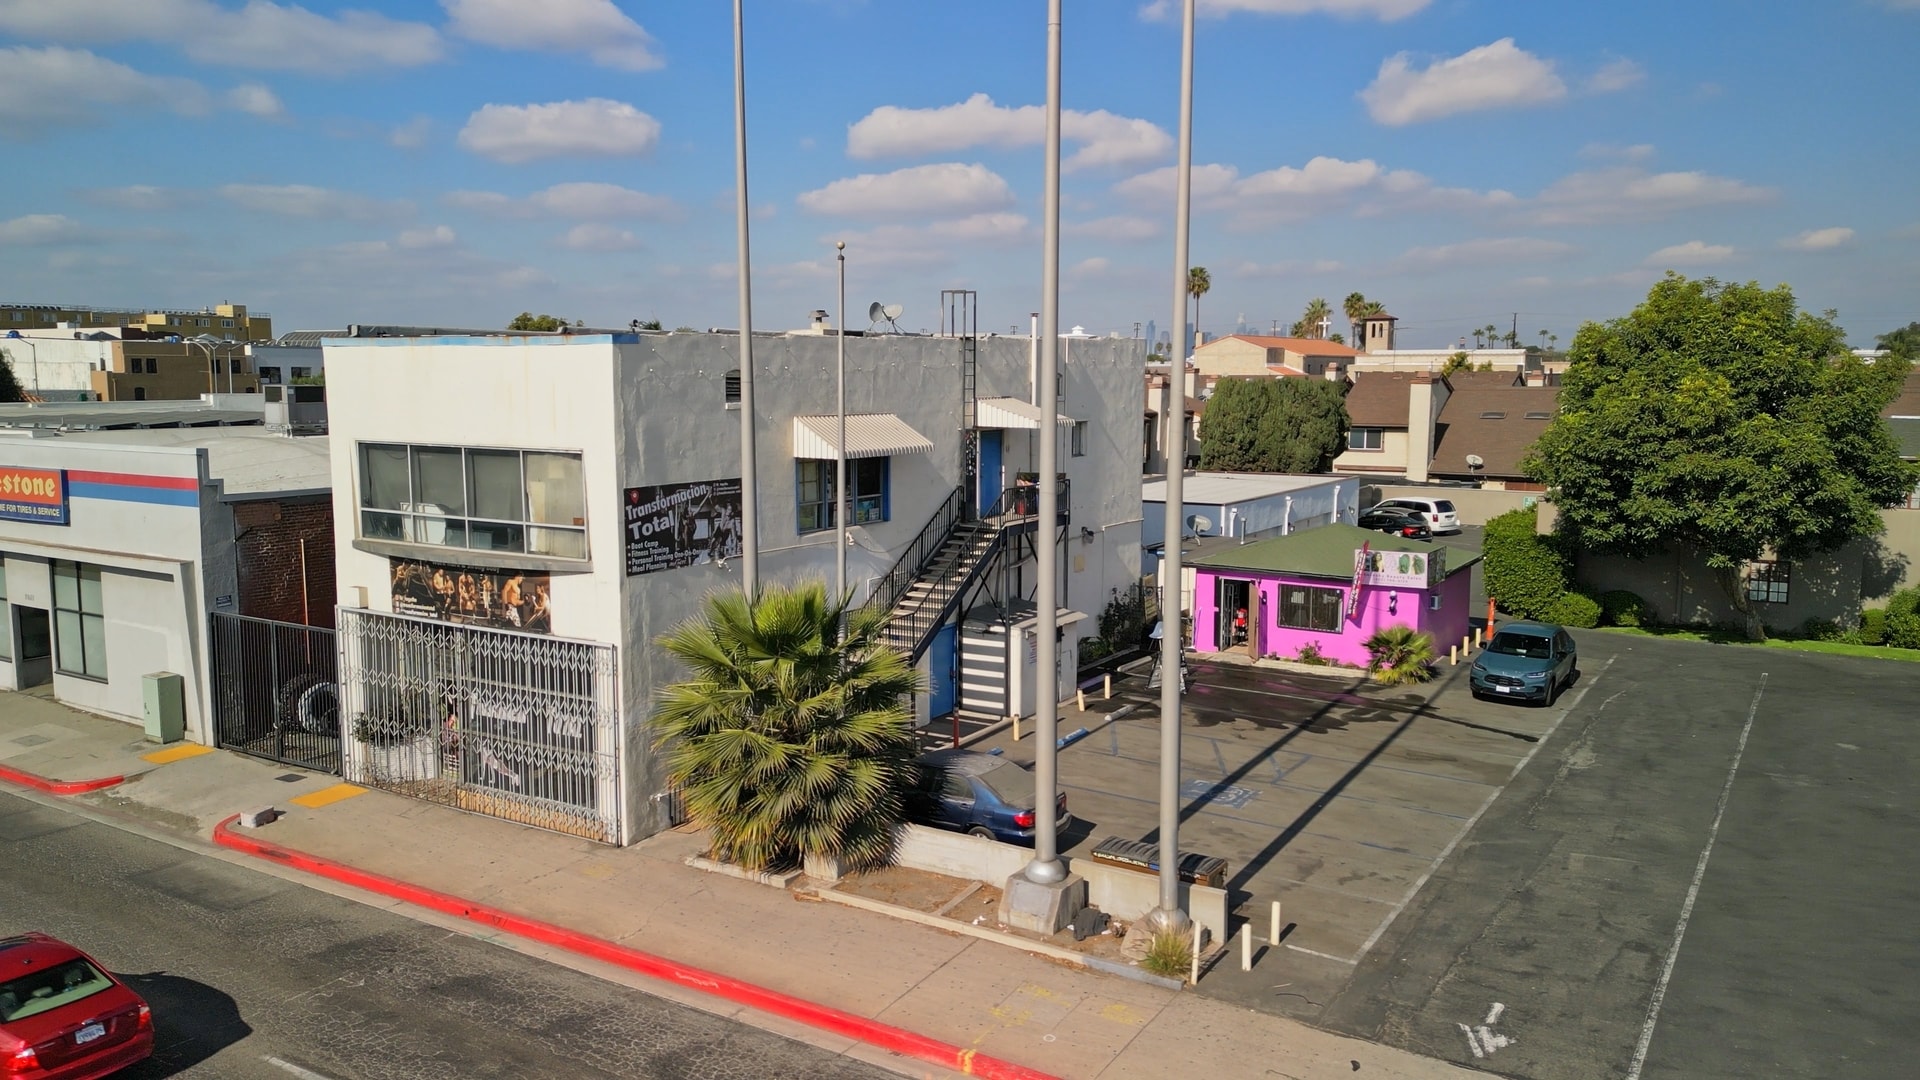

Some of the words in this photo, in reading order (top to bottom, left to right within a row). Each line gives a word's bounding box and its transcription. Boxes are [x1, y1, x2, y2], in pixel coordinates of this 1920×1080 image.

[0, 473, 55, 498] stone
[625, 484, 707, 520] Transformacion
[6, 504, 17, 513] FOR
[17, 505, 32, 514] TIRES
[38, 507, 60, 517] SERVICE
[628, 510, 675, 540] Total
[631, 542, 643, 550] Boot
[644, 540, 658, 548] Camp
[631, 550, 649, 558] Fitness
[649, 547, 670, 555] Training
[631, 555, 653, 565] Personal
[654, 553, 674, 563] Training
[632, 564, 645, 573] Meal
[645, 562, 668, 572] Planning
